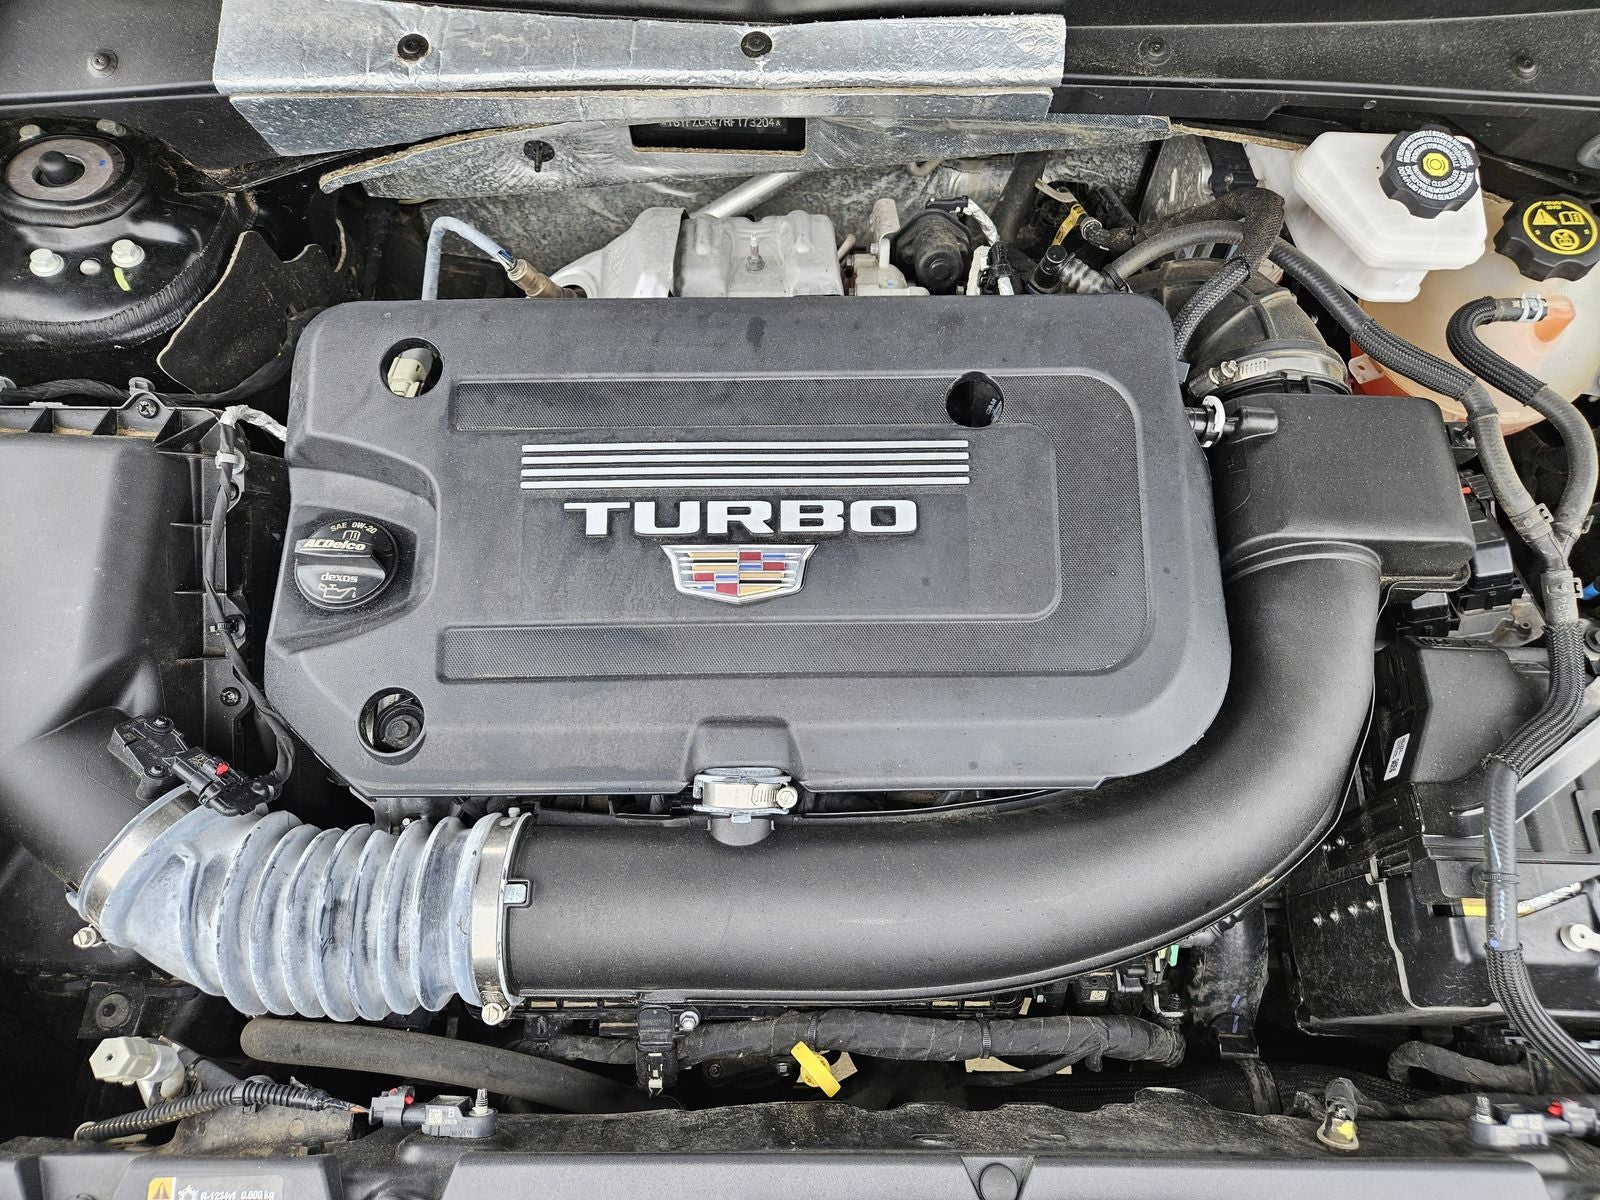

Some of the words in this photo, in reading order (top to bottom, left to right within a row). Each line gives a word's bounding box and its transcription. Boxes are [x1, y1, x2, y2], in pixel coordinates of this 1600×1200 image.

[1397, 167, 1407, 176] DOT
[1404, 178, 1419, 192] FLUID
[1417, 189, 1432, 199] FROM
[1409, 175, 1427, 190] BEFORE
[564, 499, 918, 537] TURBO
[330, 522, 348, 532] SAE
[352, 522, 378, 534] 0W-20
[303, 538, 366, 551] ACDelco
[320, 572, 358, 582] dexos
